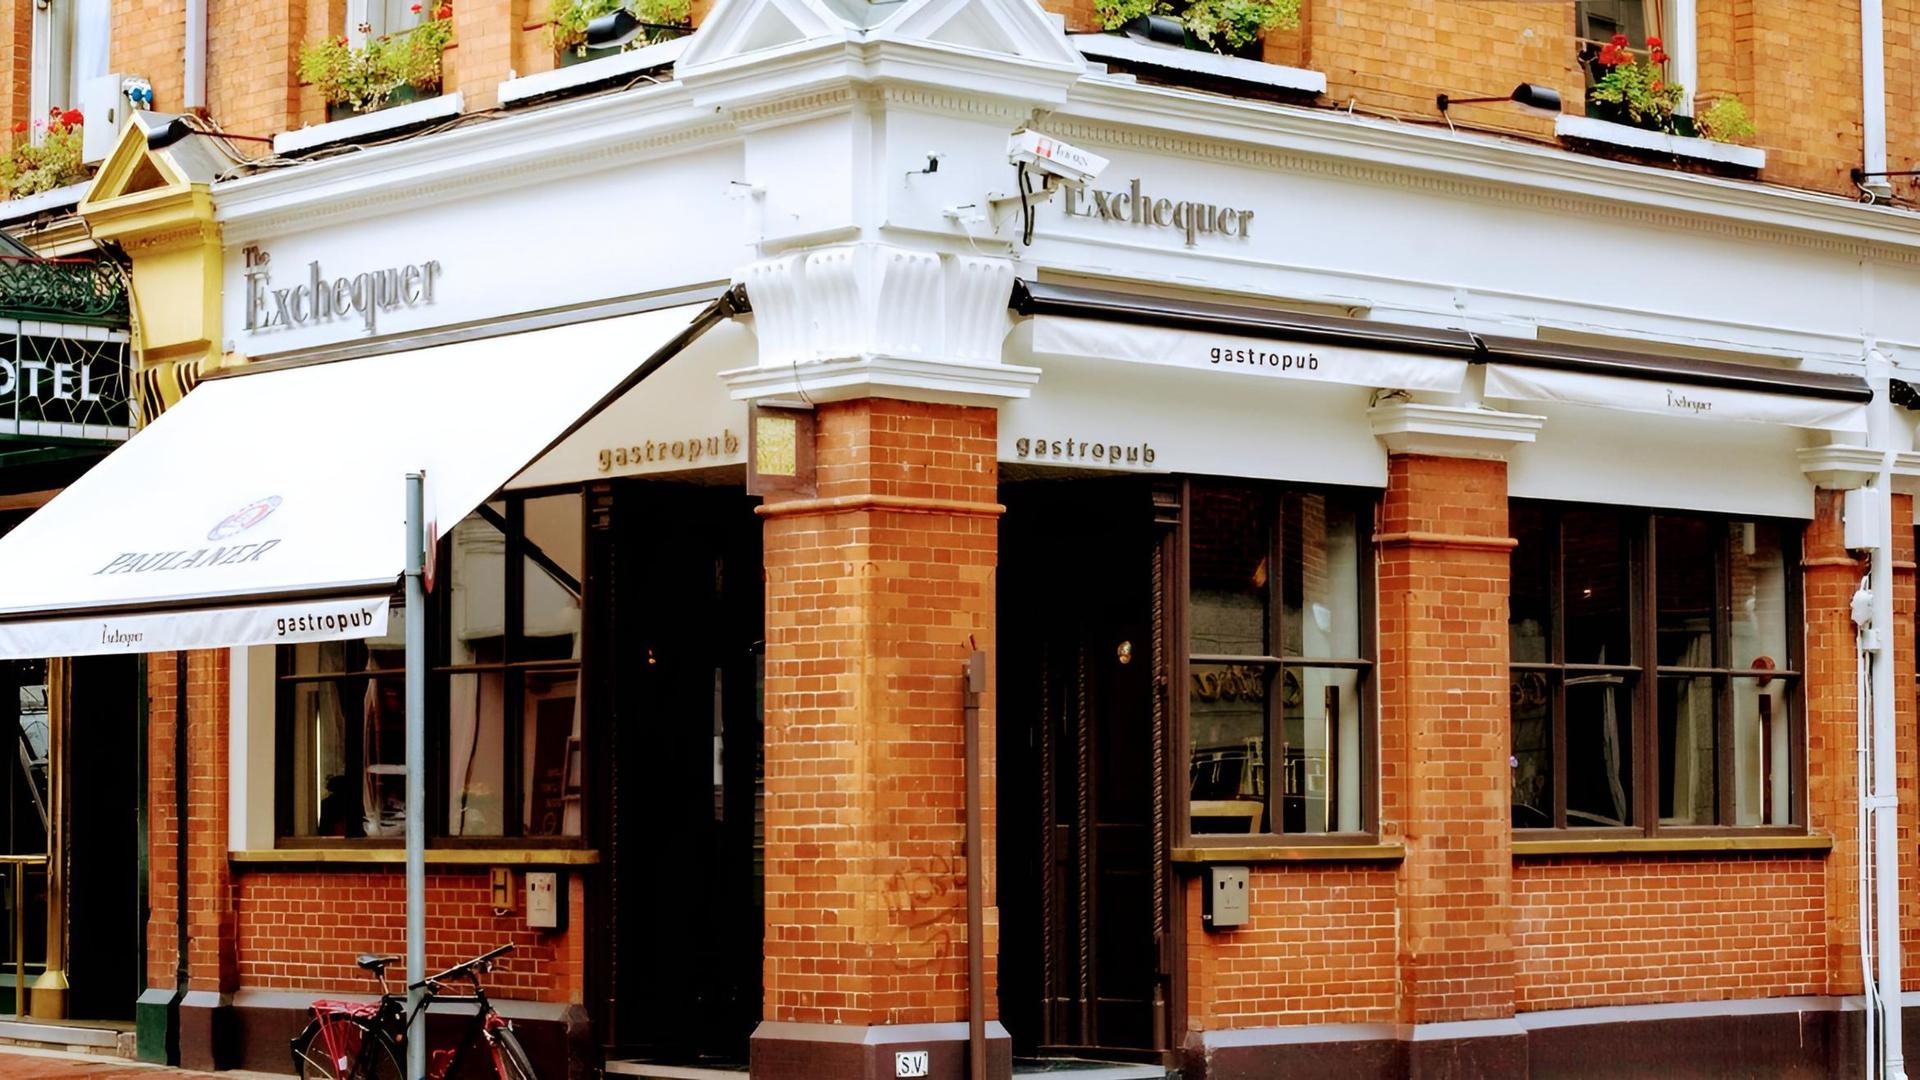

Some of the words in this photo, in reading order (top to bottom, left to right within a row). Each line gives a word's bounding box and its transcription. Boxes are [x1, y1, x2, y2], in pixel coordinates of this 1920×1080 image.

[1063, 178, 1255, 246] Exchequer
[242, 245, 270, 268] The
[242, 259, 441, 335] Exchequer
[1210, 346, 1318, 371] gastropub
[598, 428, 739, 473] gastropub
[1016, 437, 1156, 464] gastropub
[93, 538, 282, 576] PAULANER
[277, 607, 373, 636] gastropub
